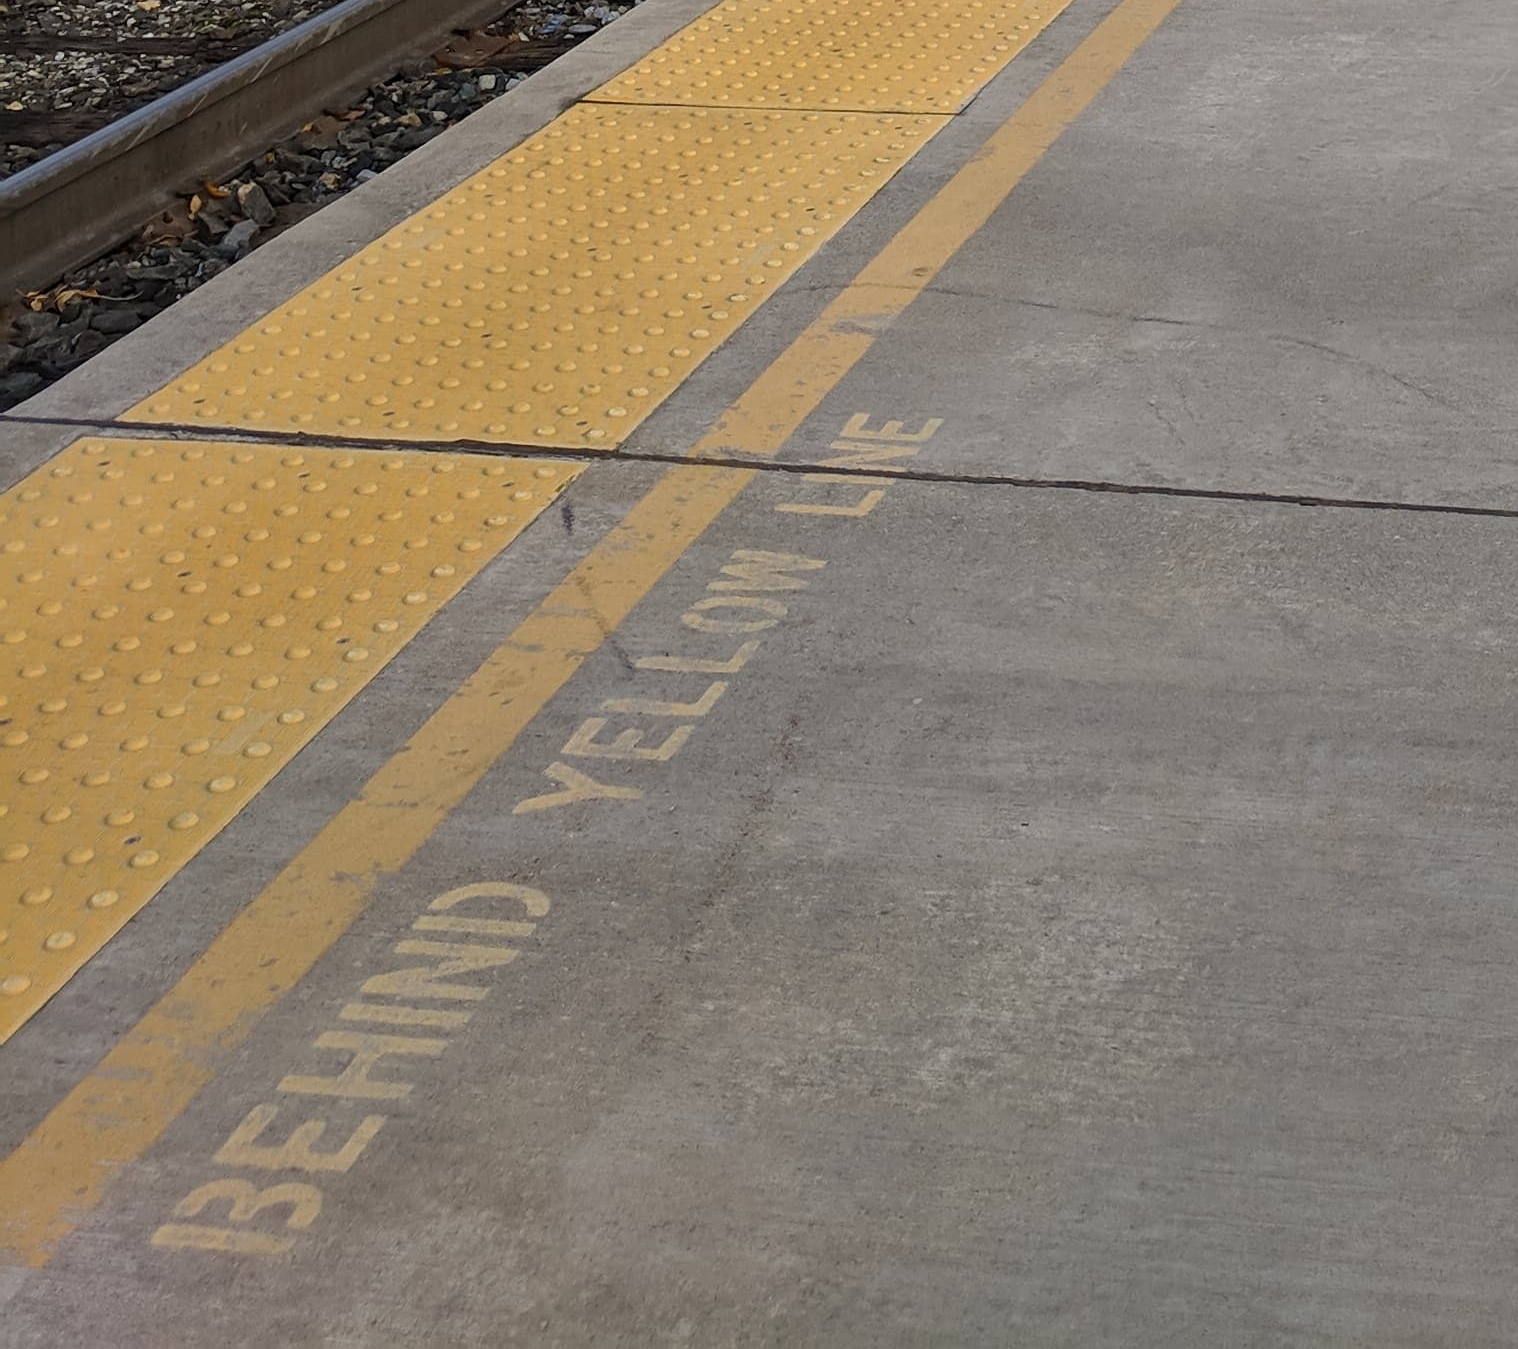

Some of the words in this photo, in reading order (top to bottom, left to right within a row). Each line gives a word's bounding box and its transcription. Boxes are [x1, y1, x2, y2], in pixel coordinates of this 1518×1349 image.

[150, 881, 551, 1254] BEHIND
[511, 548, 828, 815] YELLOW
[774, 412, 944, 518] LINE
